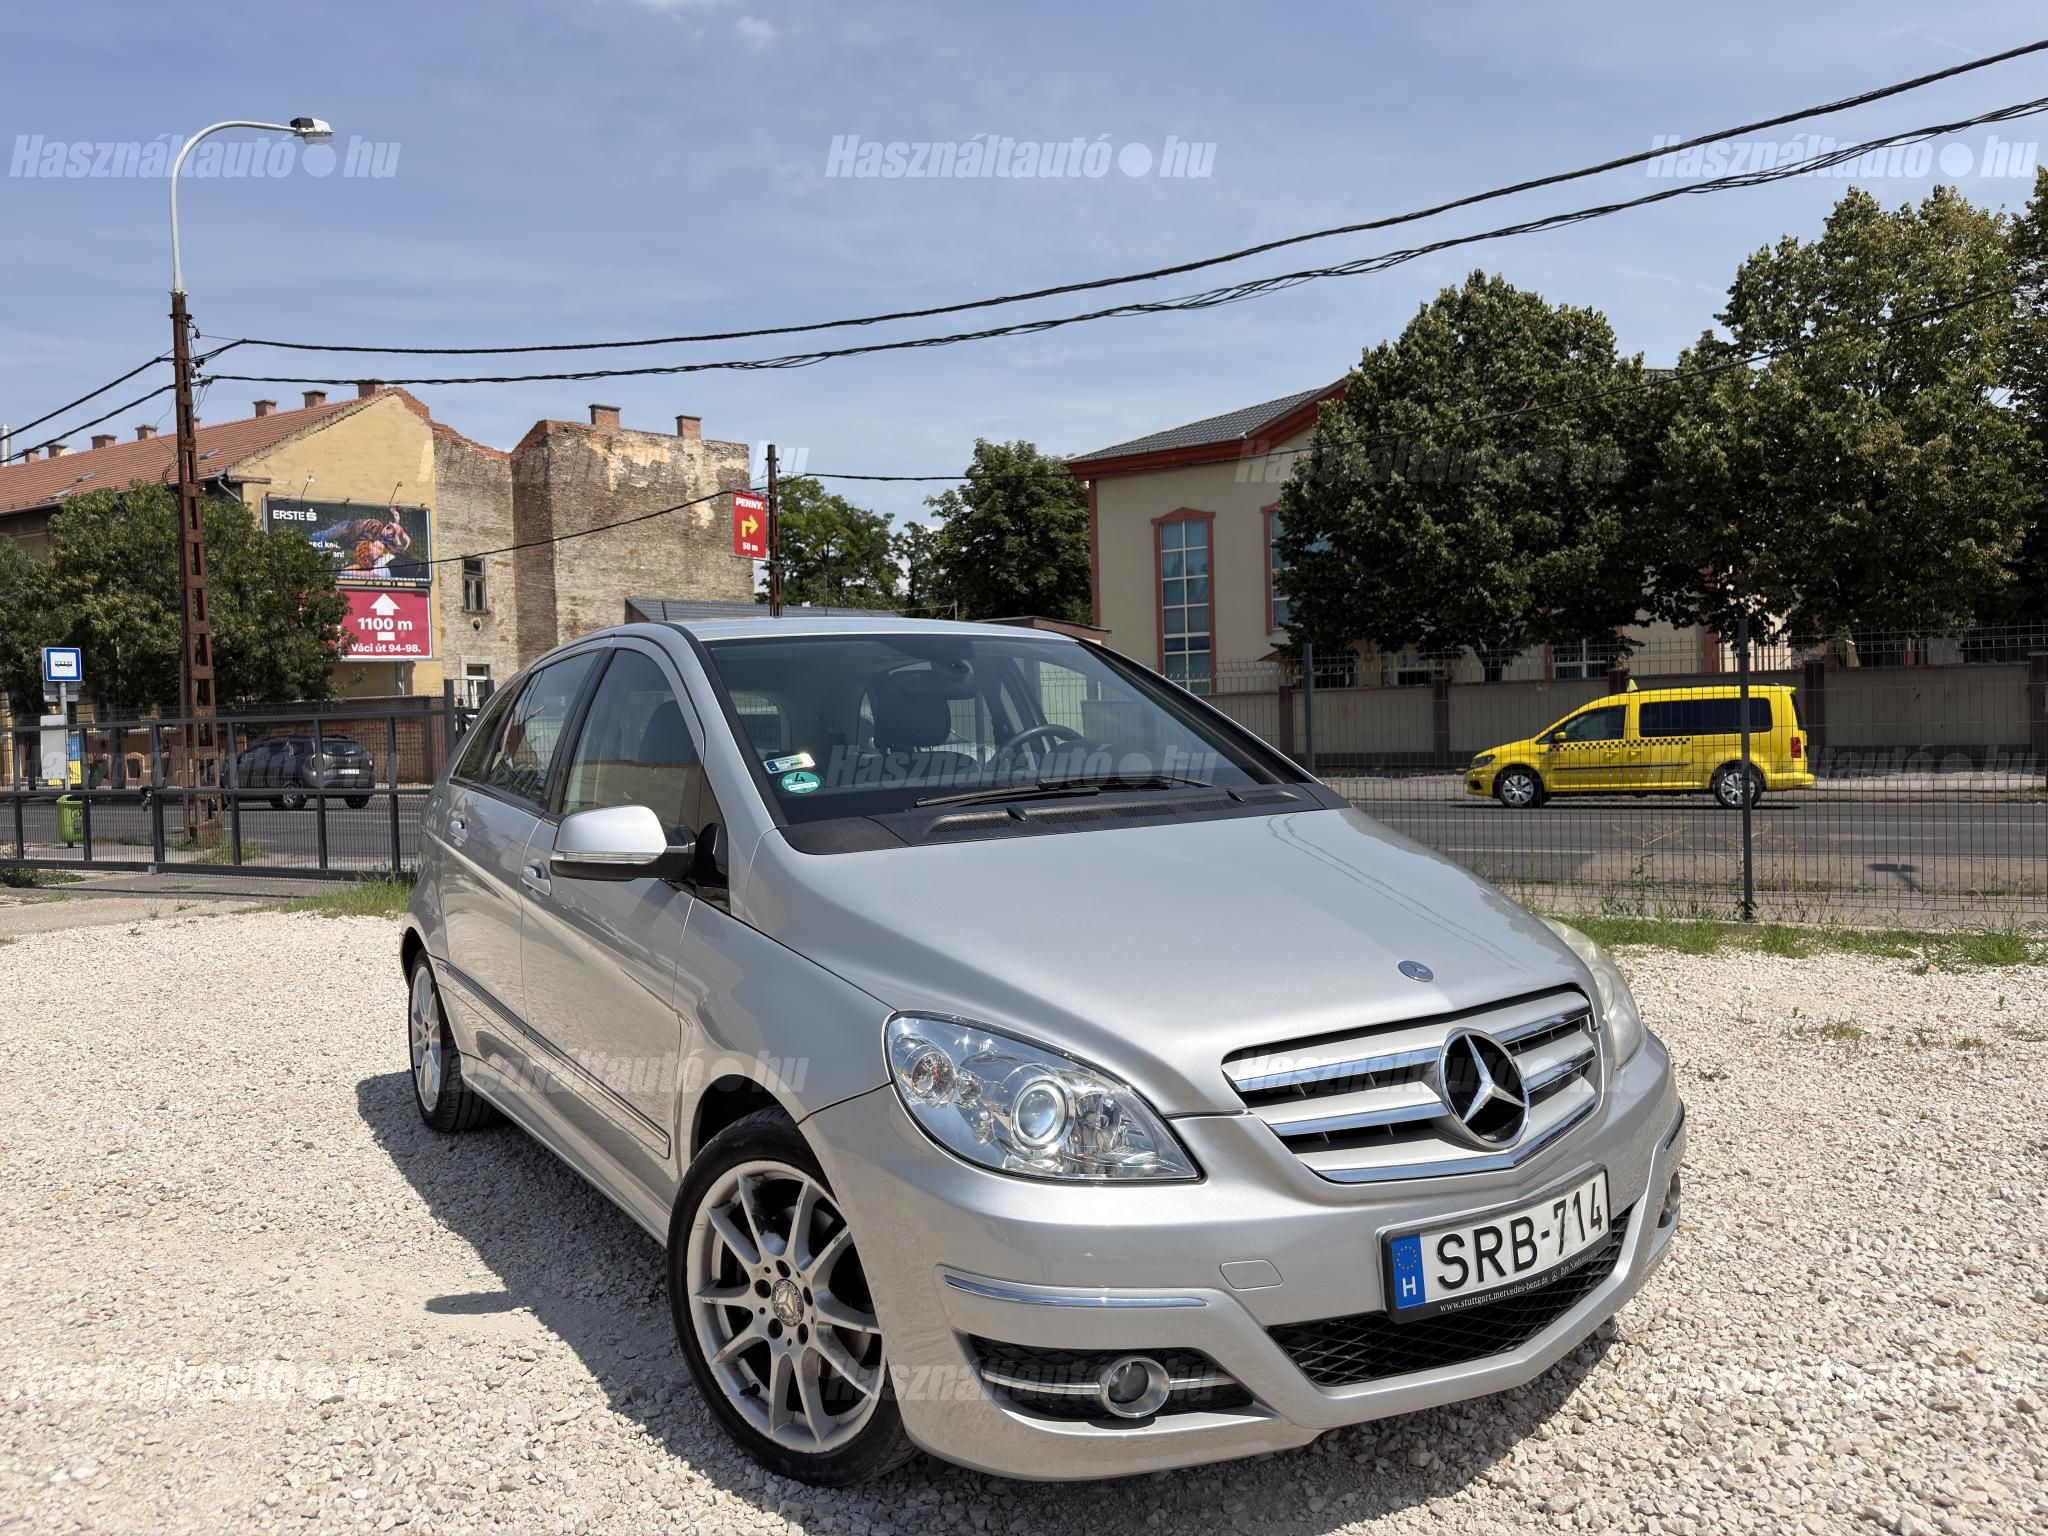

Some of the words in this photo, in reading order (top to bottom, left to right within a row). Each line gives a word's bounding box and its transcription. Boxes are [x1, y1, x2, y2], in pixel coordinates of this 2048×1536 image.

[273, 510, 305, 521] ERSTE
[742, 541, 751, 551] 50
[751, 544, 759, 552] m
[358, 617, 394, 631] 1100
[397, 620, 413, 631] m
[351, 643, 373, 653] Váci
[375, 643, 387, 653] út
[388, 643, 422, 653] 94-98.
[1436, 1182, 1603, 1290] SRB-714
[1402, 1276, 1417, 1297] H
